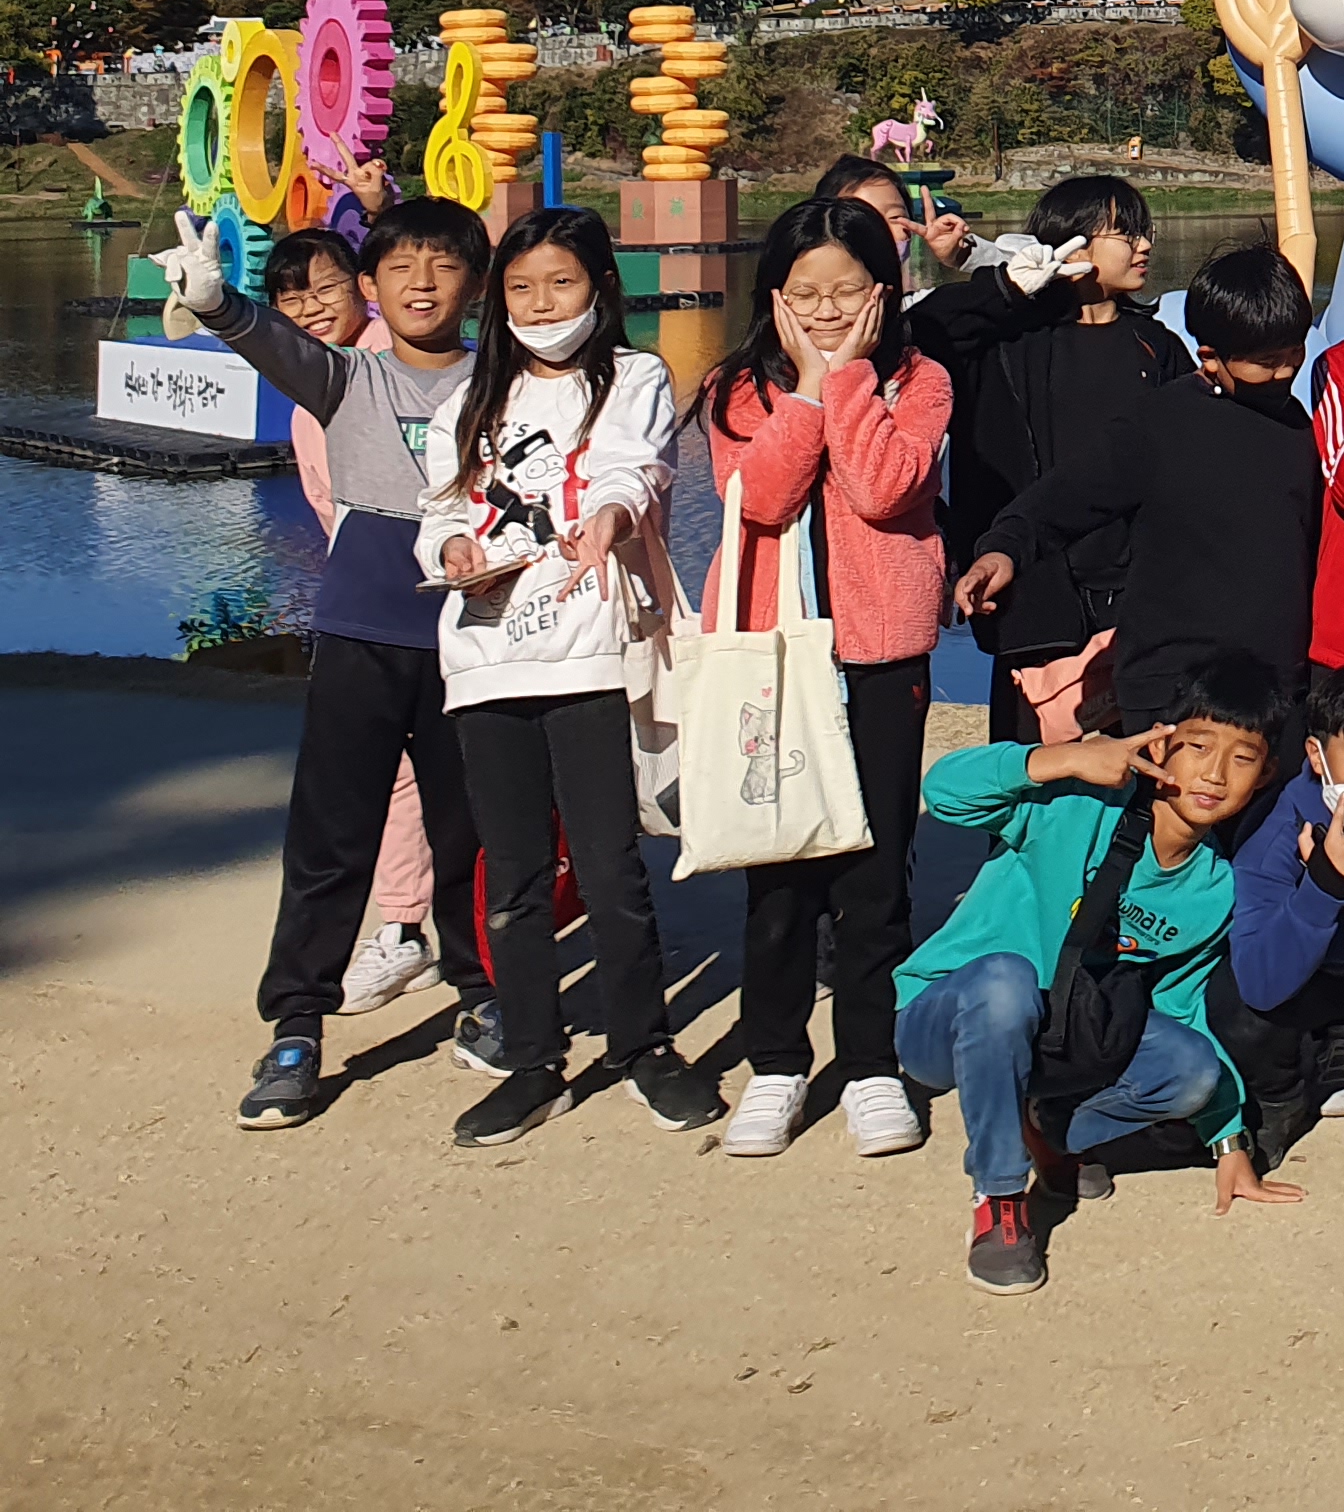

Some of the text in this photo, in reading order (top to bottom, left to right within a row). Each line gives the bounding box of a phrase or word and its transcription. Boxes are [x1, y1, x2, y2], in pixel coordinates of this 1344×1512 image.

[150, 367, 163, 402] 강
[198, 374, 225, 408] 담다
[508, 611, 558, 646] ULE!
